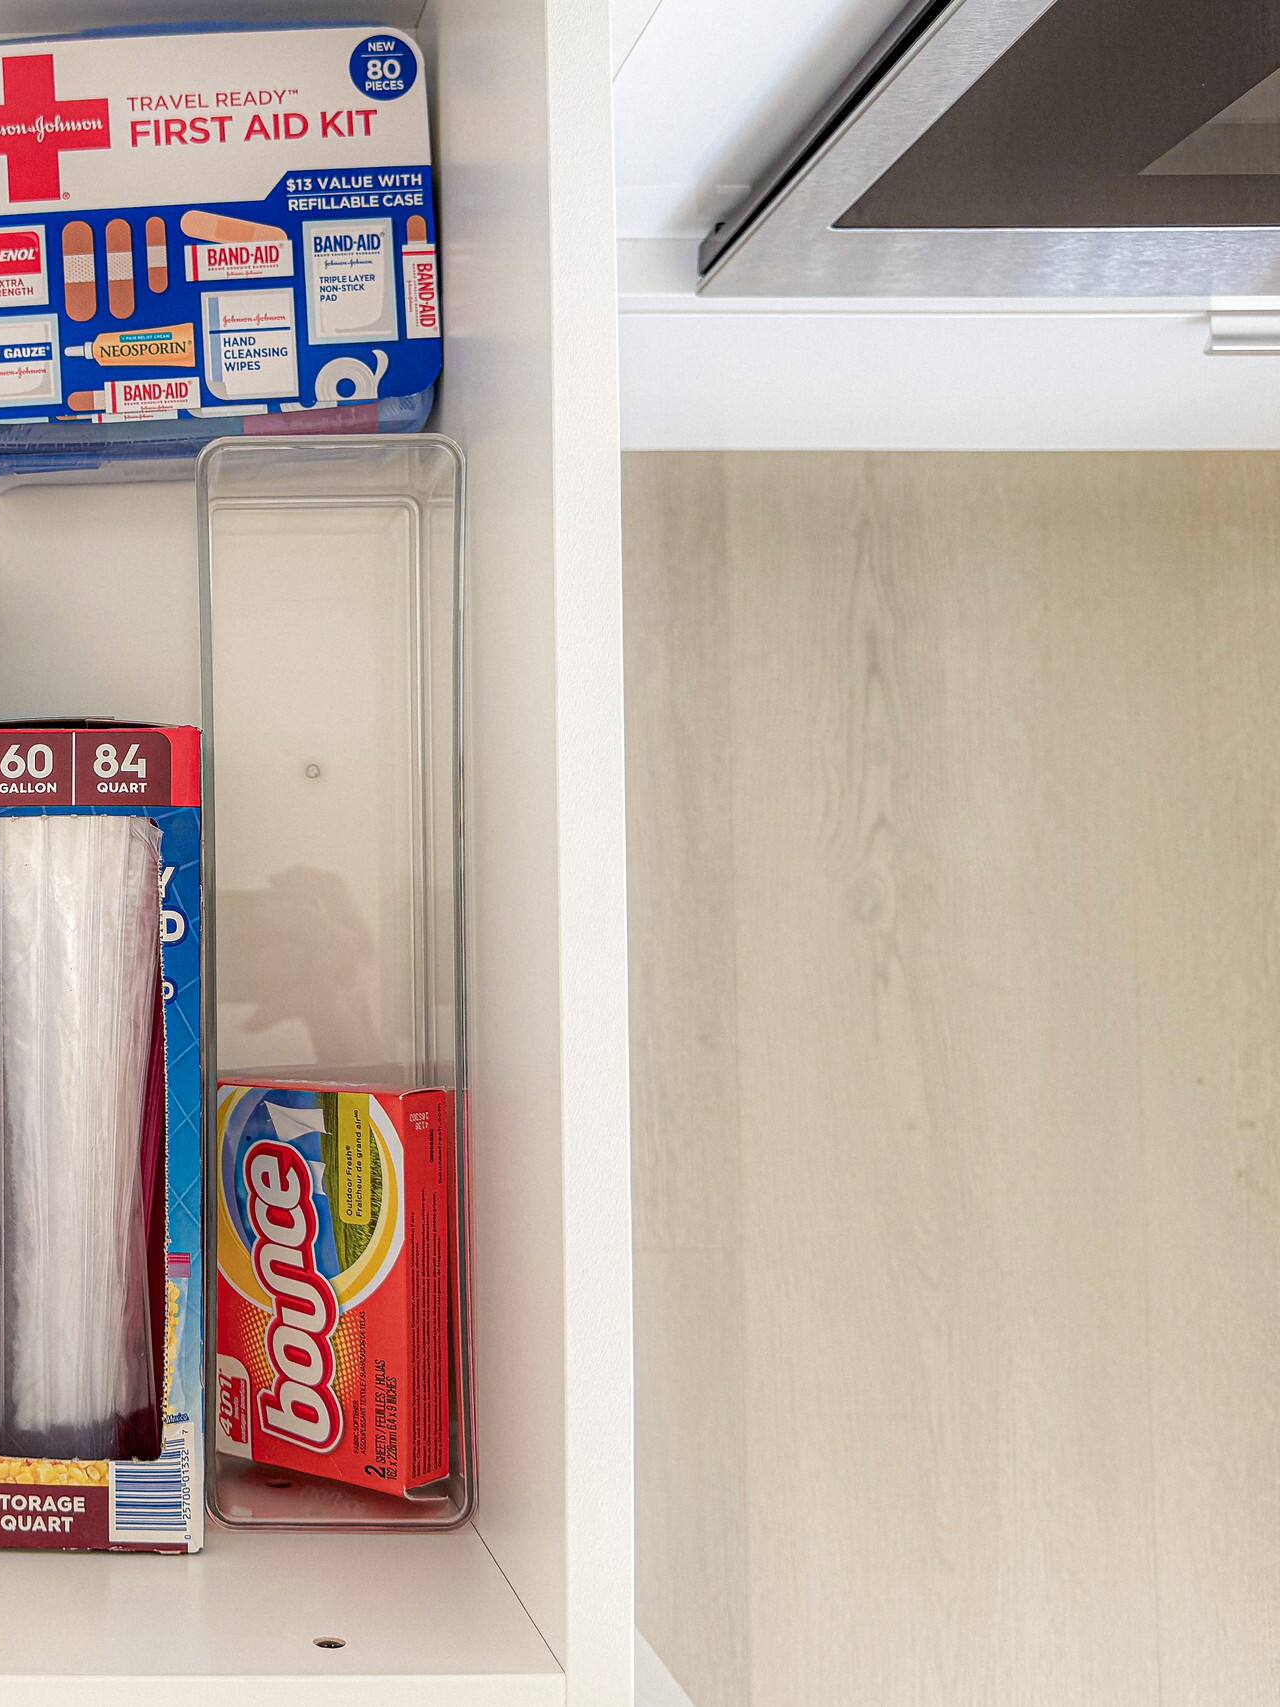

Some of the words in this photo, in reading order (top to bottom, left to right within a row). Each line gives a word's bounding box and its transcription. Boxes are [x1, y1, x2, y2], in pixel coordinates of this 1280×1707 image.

[367, 41, 395, 52] NEW
[366, 59, 401, 81] 80
[365, 80, 405, 92] PIECES
[126, 94, 209, 112] TRAVEL
[130, 115, 233, 148] FIRST
[243, 112, 309, 142] AID
[320, 109, 378, 139] KIT
[286, 178, 313, 192] $13
[317, 175, 374, 190] VALUE
[378, 174, 422, 188] WITH
[288, 195, 380, 212] REFILLABLE
[382, 193, 424, 207] CASE
[319, 275, 348, 284] TRIPLE
[349, 274, 376, 282] LAYER
[319, 283, 365, 293] NON-STICK
[320, 294, 338, 302] PAD
[223, 337, 256, 347] HAND
[3, 347, 46, 358] GAUZE
[224, 347, 288, 359] CLEANSING
[224, 361, 261, 372] WIPES
[0, 743, 54, 779] 60
[92, 743, 147, 779] 84
[96, 781, 148, 794] QUART
[354, 1131, 362, 1159] grand
[355, 1162, 362, 1173] de
[250, 1153, 332, 1444] bounce
[375, 1359, 386, 1386] HOJAS
[375, 1393, 386, 1429] FEUILLES
[376, 1433, 386, 1464] SHEETS
[364, 1464, 386, 1480] 2
[0, 1515, 74, 1534] QUART
